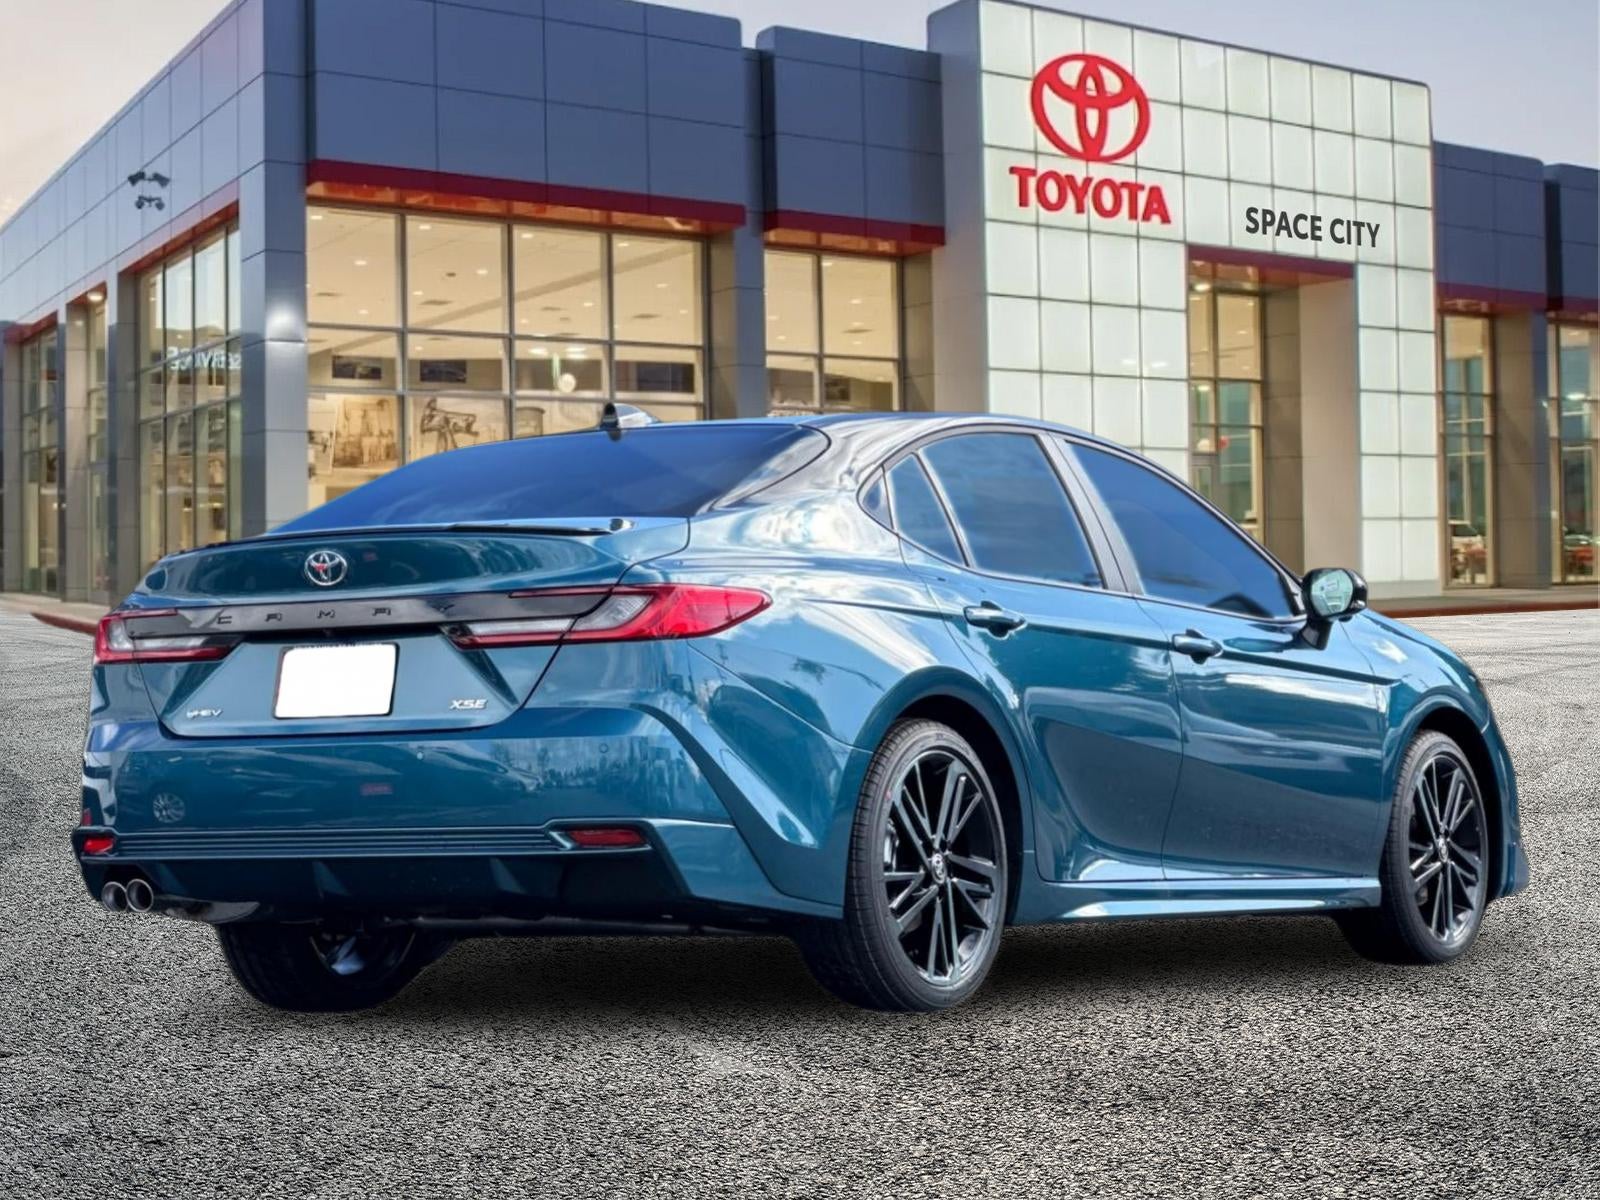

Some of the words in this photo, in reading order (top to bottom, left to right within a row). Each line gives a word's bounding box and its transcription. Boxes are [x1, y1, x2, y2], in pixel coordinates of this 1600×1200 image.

[1009, 166, 1171, 224] TOYOTA
[1245, 206, 1322, 242] SPACE
[1329, 218, 1381, 248] CITY
[450, 699, 488, 709] XSE
